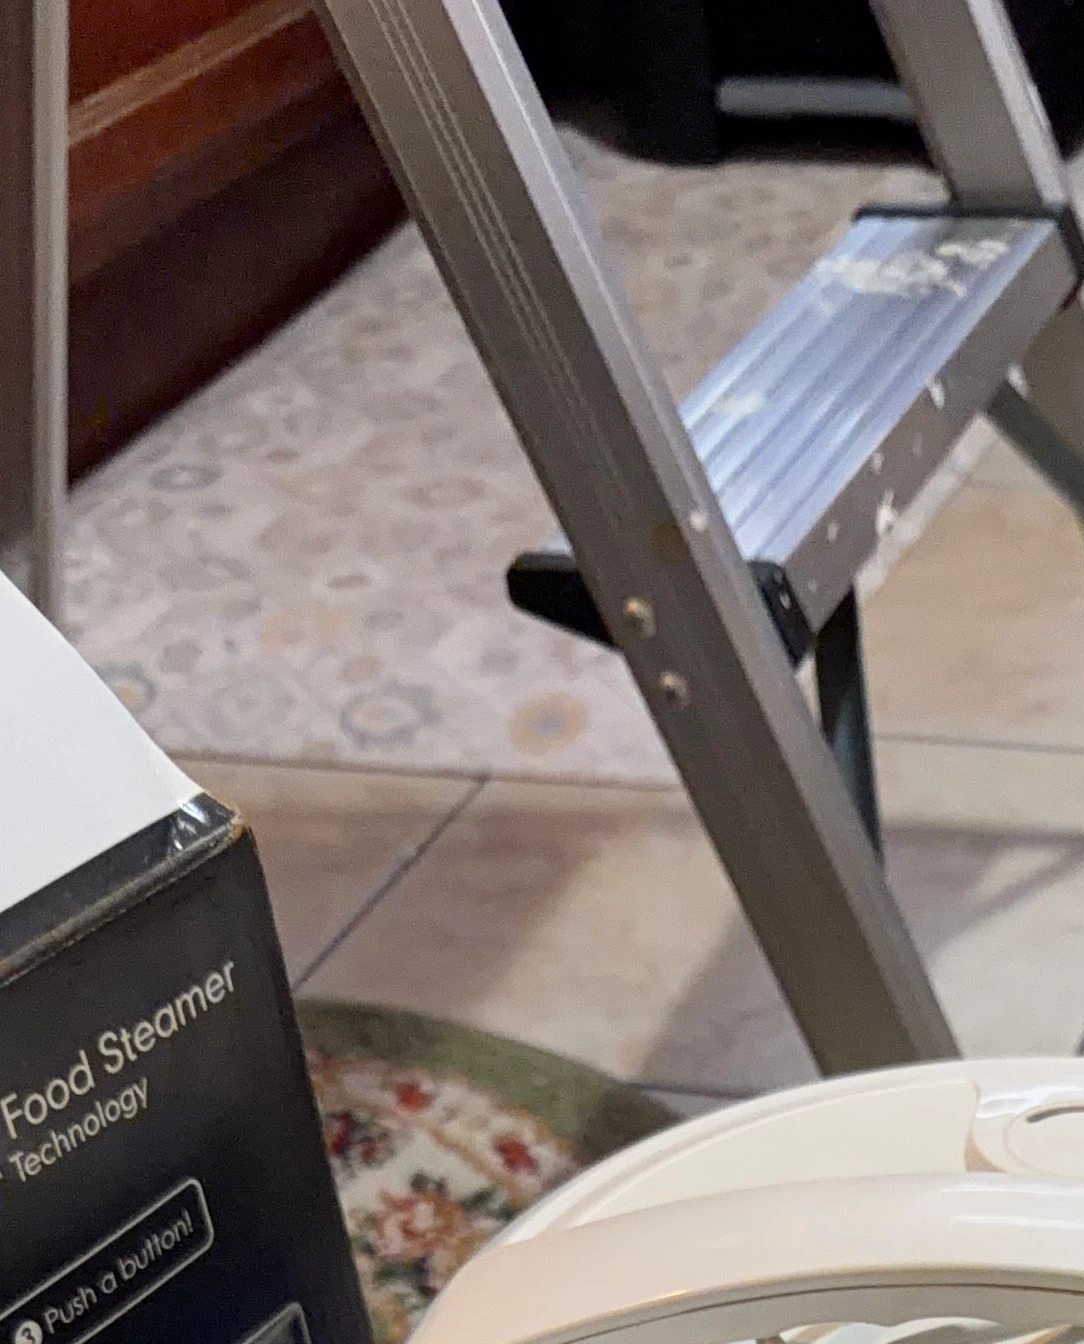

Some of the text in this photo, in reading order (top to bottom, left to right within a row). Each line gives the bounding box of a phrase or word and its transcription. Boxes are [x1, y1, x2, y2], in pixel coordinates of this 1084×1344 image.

[2, 959, 237, 1140] Food Steamer
[8, 1077, 150, 1183] Technology
[43, 1284, 98, 1335] Push
[101, 1270, 118, 1294] a
[117, 1208, 195, 1282] button!
